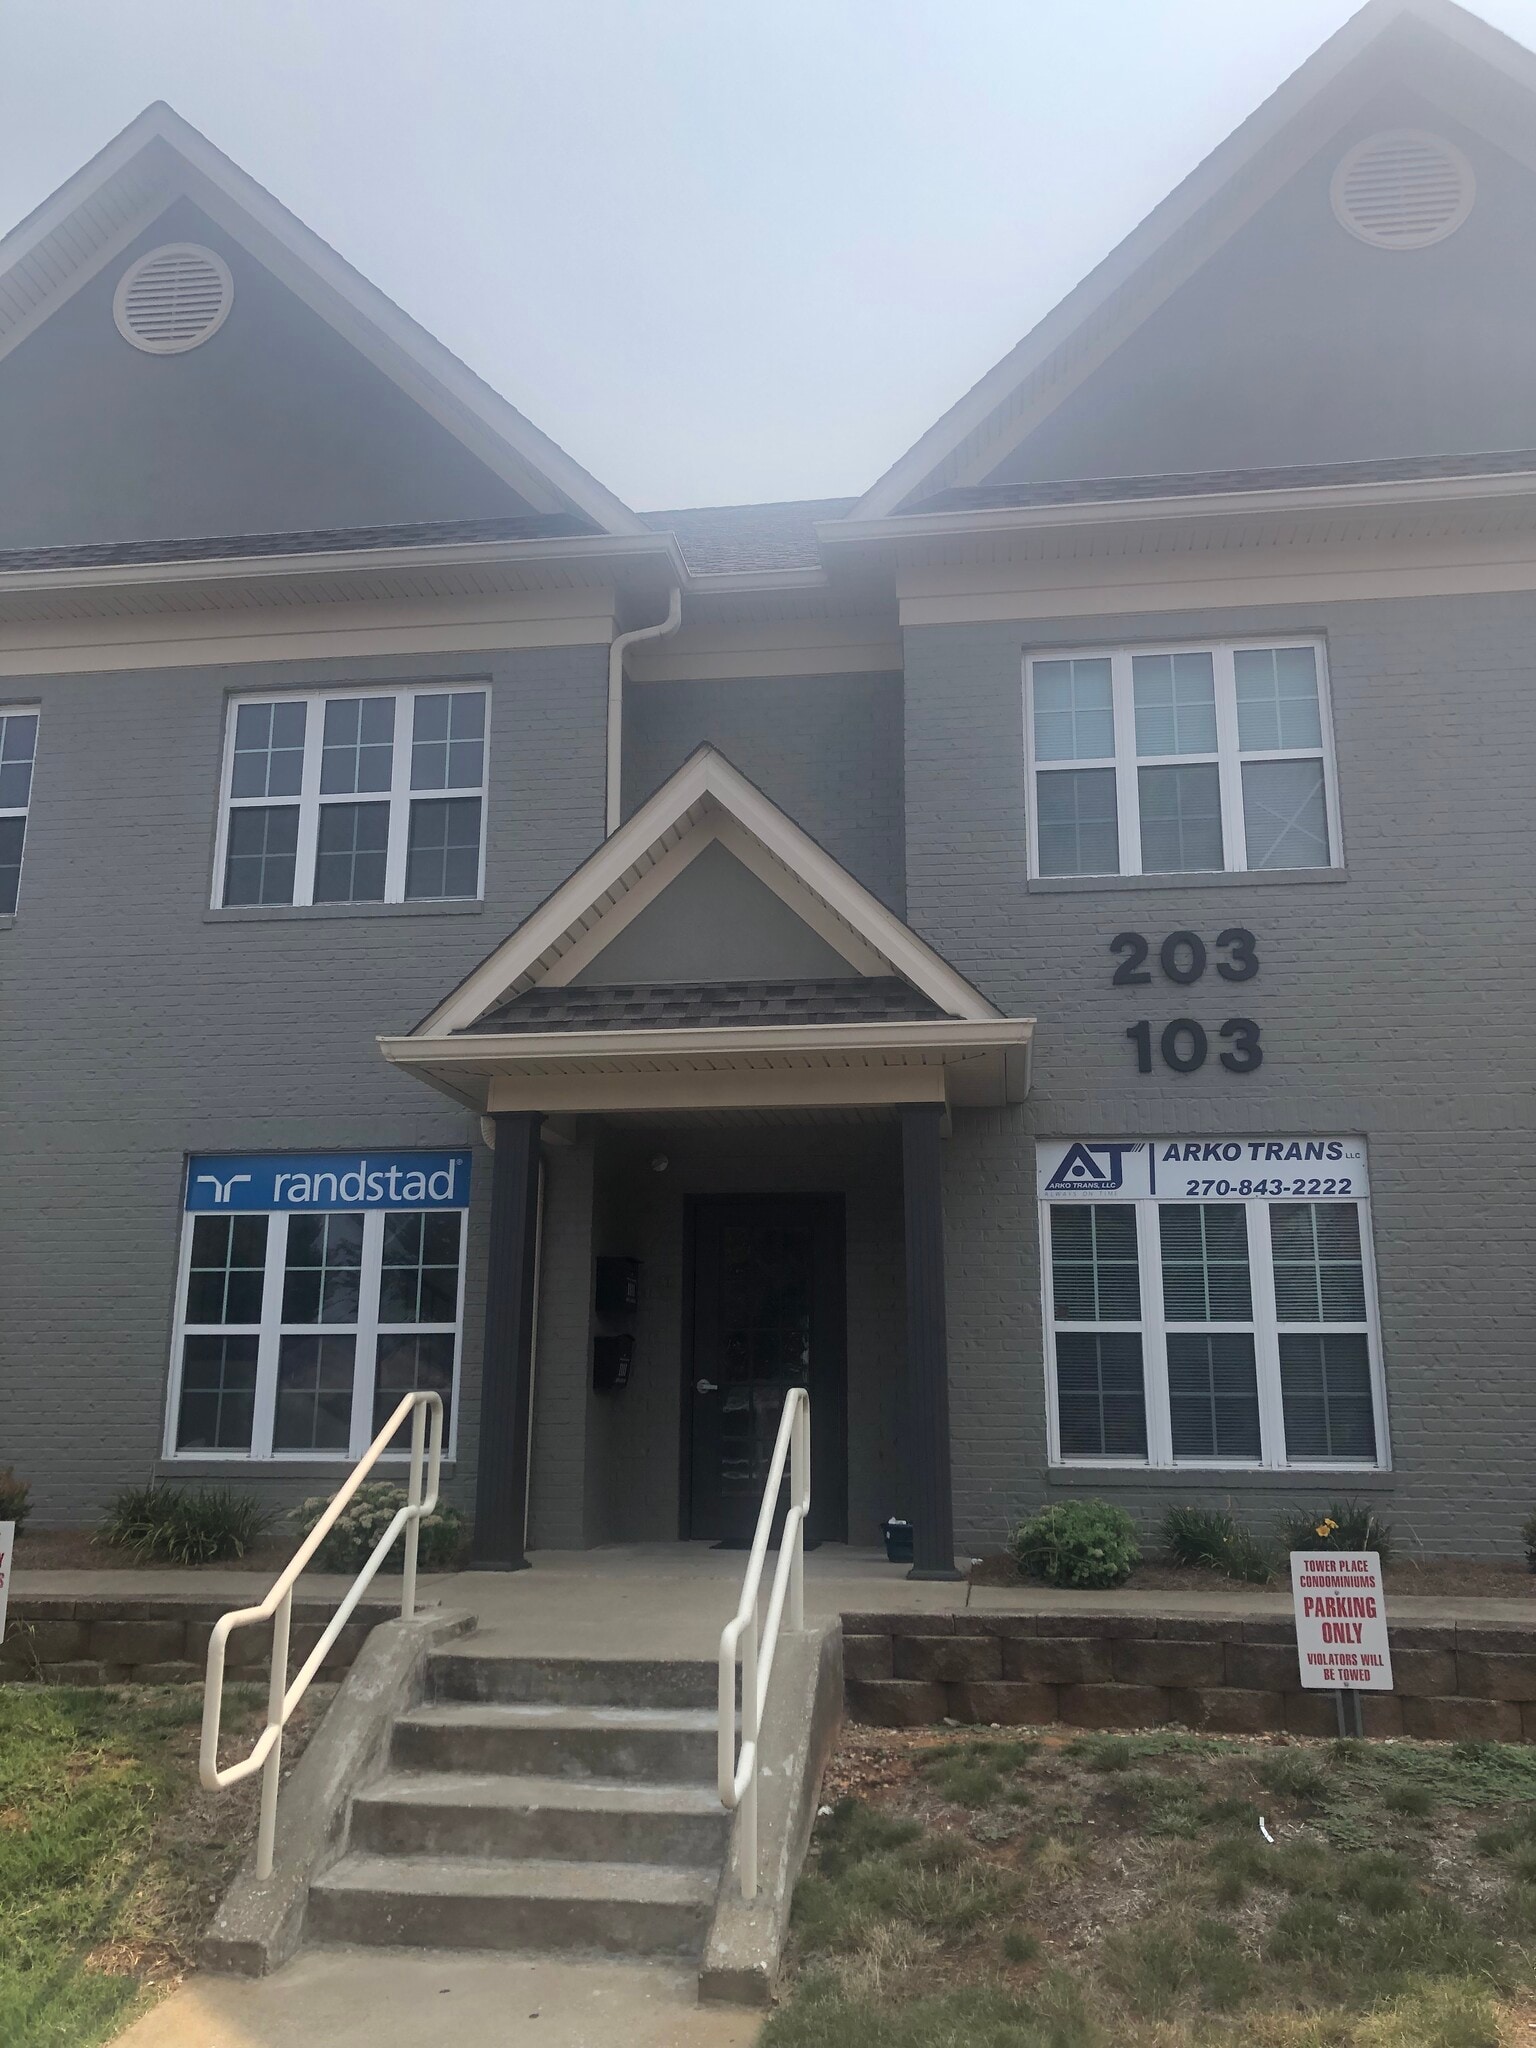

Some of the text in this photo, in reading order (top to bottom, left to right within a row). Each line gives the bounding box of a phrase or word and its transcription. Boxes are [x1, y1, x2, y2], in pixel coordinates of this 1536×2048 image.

[1109, 928, 1259, 985] 203
[1126, 1017, 1263, 1073] 103
[1162, 1143, 1242, 1162] ARKO
[1248, 1142, 1344, 1161] TRANS
[273, 1158, 456, 1203] randstad
[1186, 1178, 1352, 1196] 270-843-2222
[1304, 1560, 1368, 1572] TOWER PLACE
[1300, 1576, 1375, 1588] CONDOMINIUMS
[1304, 1597, 1377, 1618] PARKING
[1322, 1622, 1362, 1644] ONLY
[1307, 1653, 1384, 1666] VIOLATORS WILL
[1324, 1669, 1371, 1682] BE TOWED
